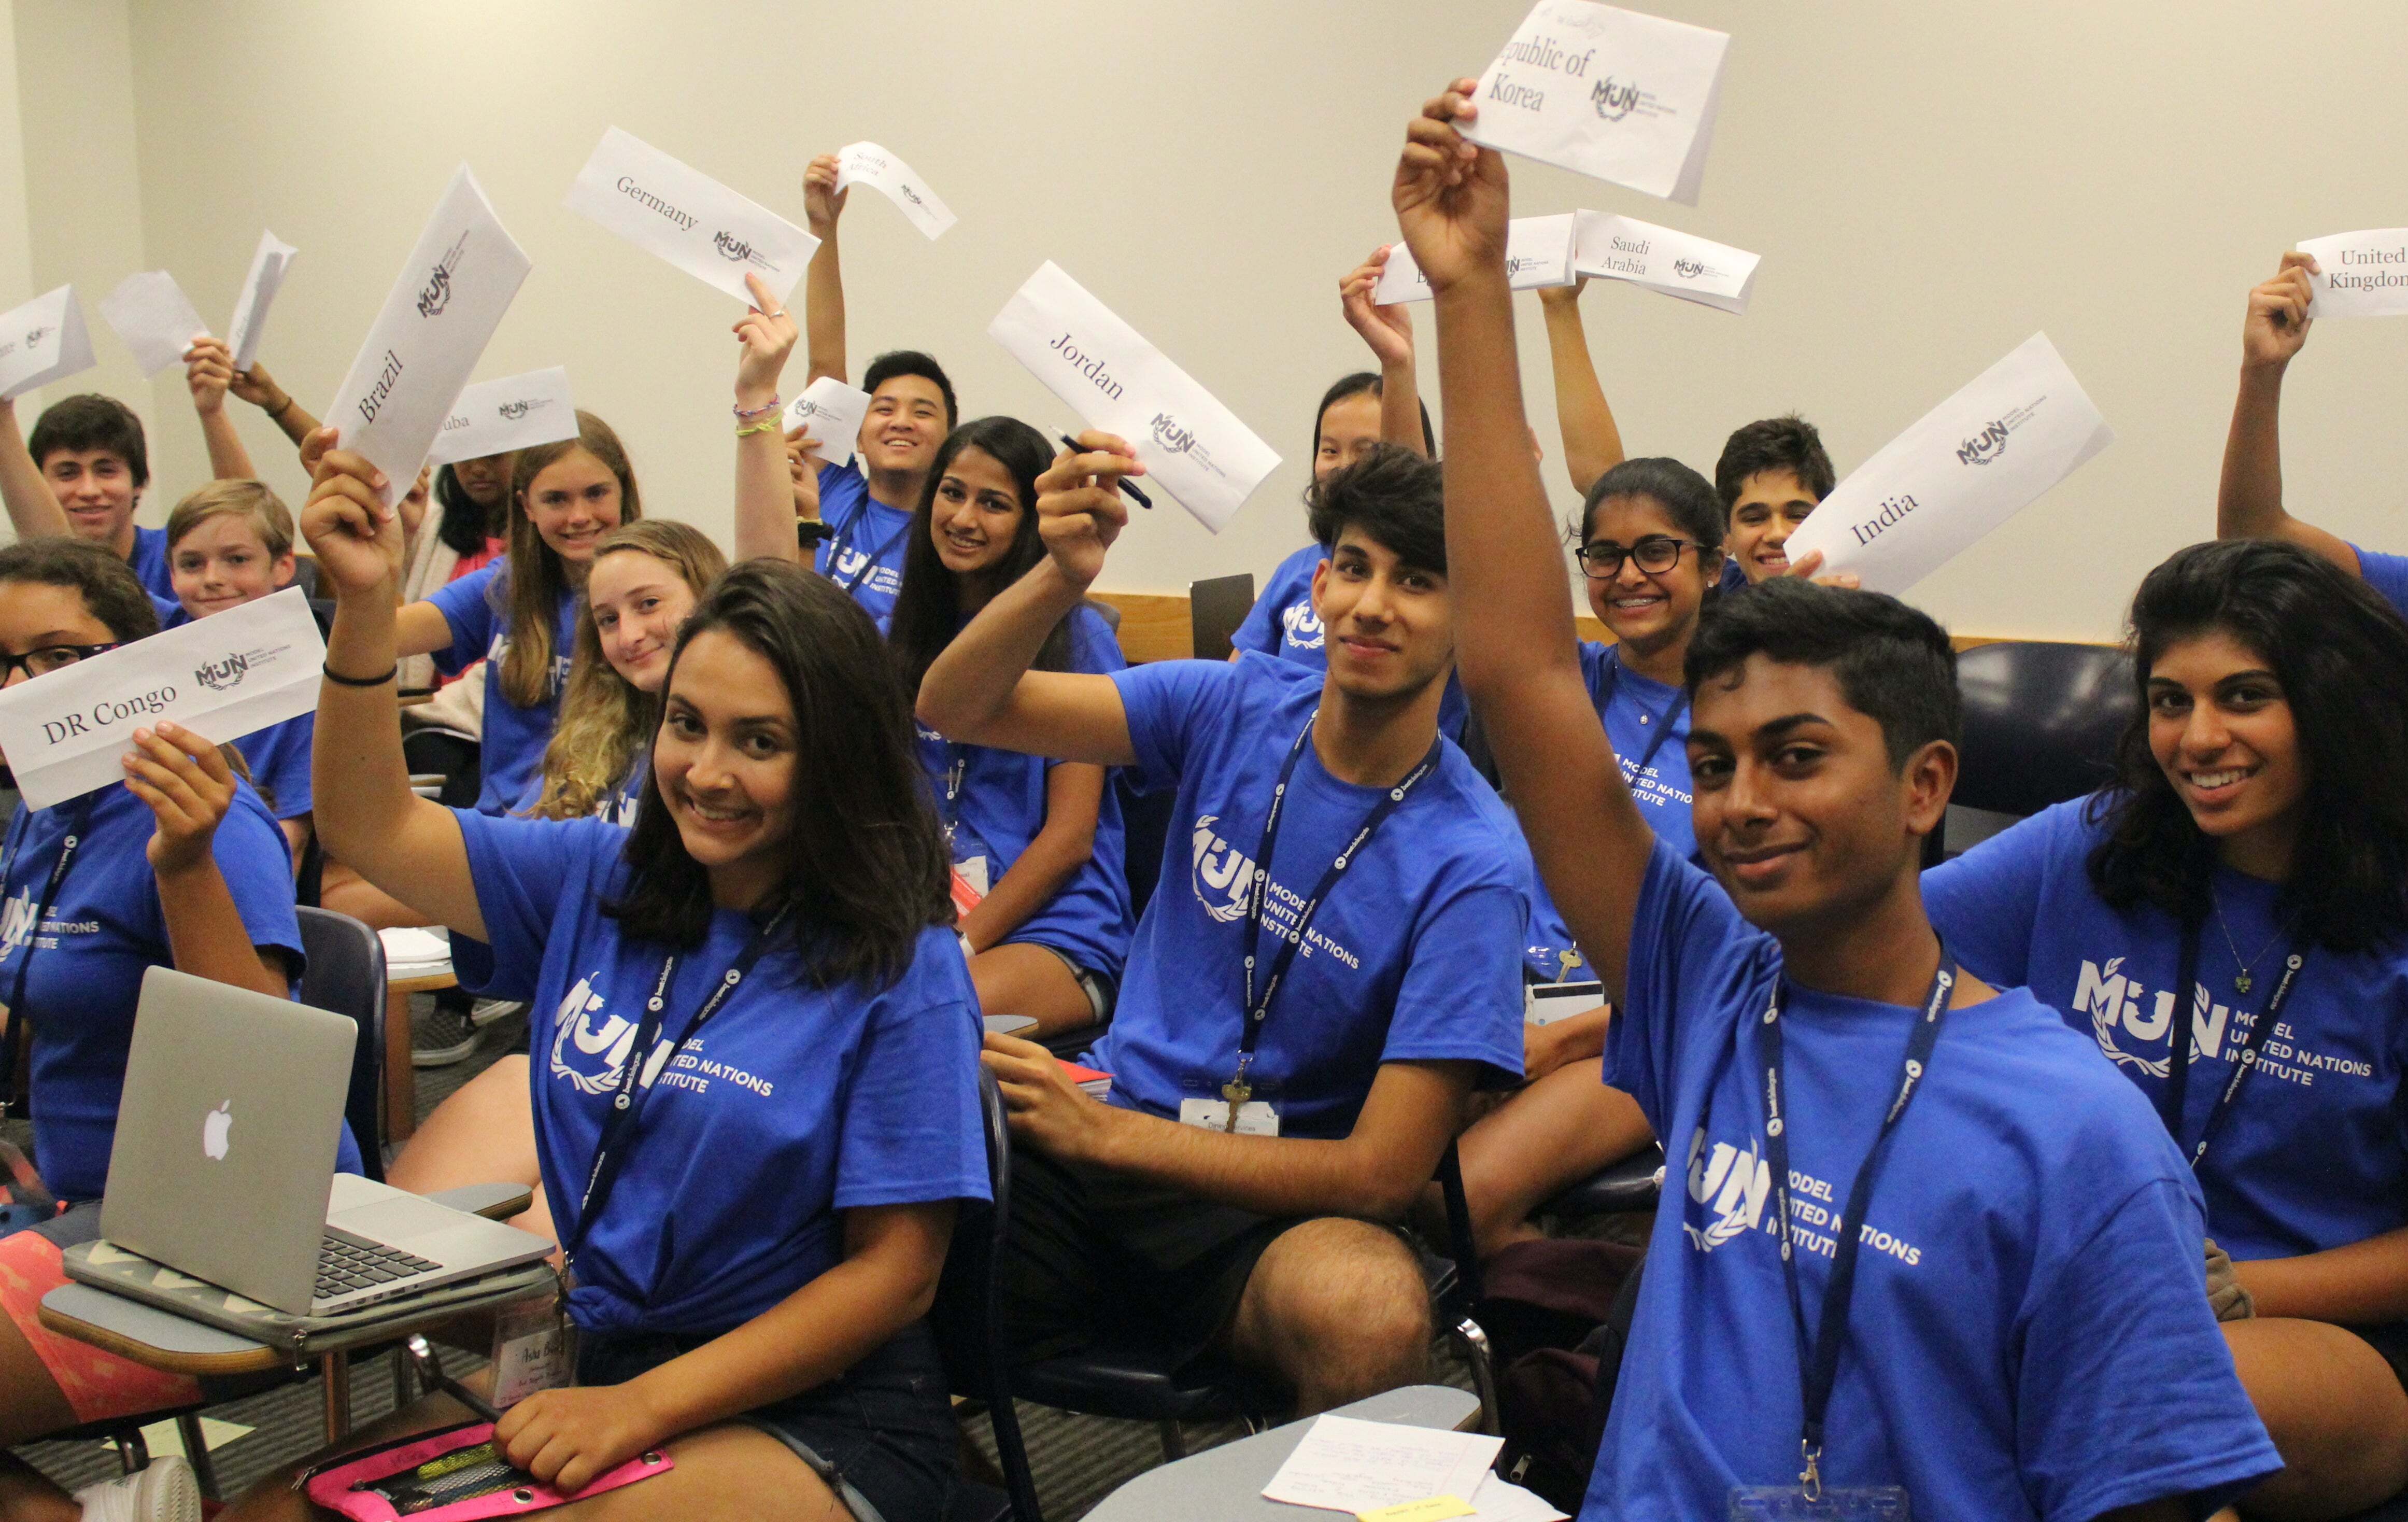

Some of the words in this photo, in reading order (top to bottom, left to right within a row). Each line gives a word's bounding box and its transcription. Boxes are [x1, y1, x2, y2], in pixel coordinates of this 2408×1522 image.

[1502, 36, 1564, 70] public
[1566, 49, 1596, 77] of
[1489, 73, 1545, 111] Korea
[854, 151, 887, 168] South
[617, 176, 699, 231] Germany
[1610, 236, 1651, 255] Saudi
[2341, 247, 2406, 265] United
[1600, 256, 1647, 275] Arabia
[1050, 332, 1124, 401] Jordan
[358, 349, 403, 425] Brazil
[443, 415, 470, 431] uba
[1150, 412, 1196, 454] MUN
[1956, 420, 2009, 466] MUN
[1850, 494, 1920, 547] India
[194, 654, 249, 686] MUN
[42, 713, 91, 745] DR
[94, 686, 177, 726] Congo
[1656, 783, 1693, 805] NATIO
[1269, 882, 1307, 912] MODE
[1263, 896, 1298, 926] UNITE
[1305, 926, 1359, 969] NATIONS
[2072, 959, 2229, 1059] MUN
[2234, 1010, 2294, 1040] MOEL
[681, 1037, 705, 1052] DEL
[2296, 1049, 2372, 1077] NATIONS
[698, 1059, 774, 1097] NATIONS
[1789, 1169, 1833, 1203] ODEL
[1830, 1214, 1922, 1266] NTIONS
